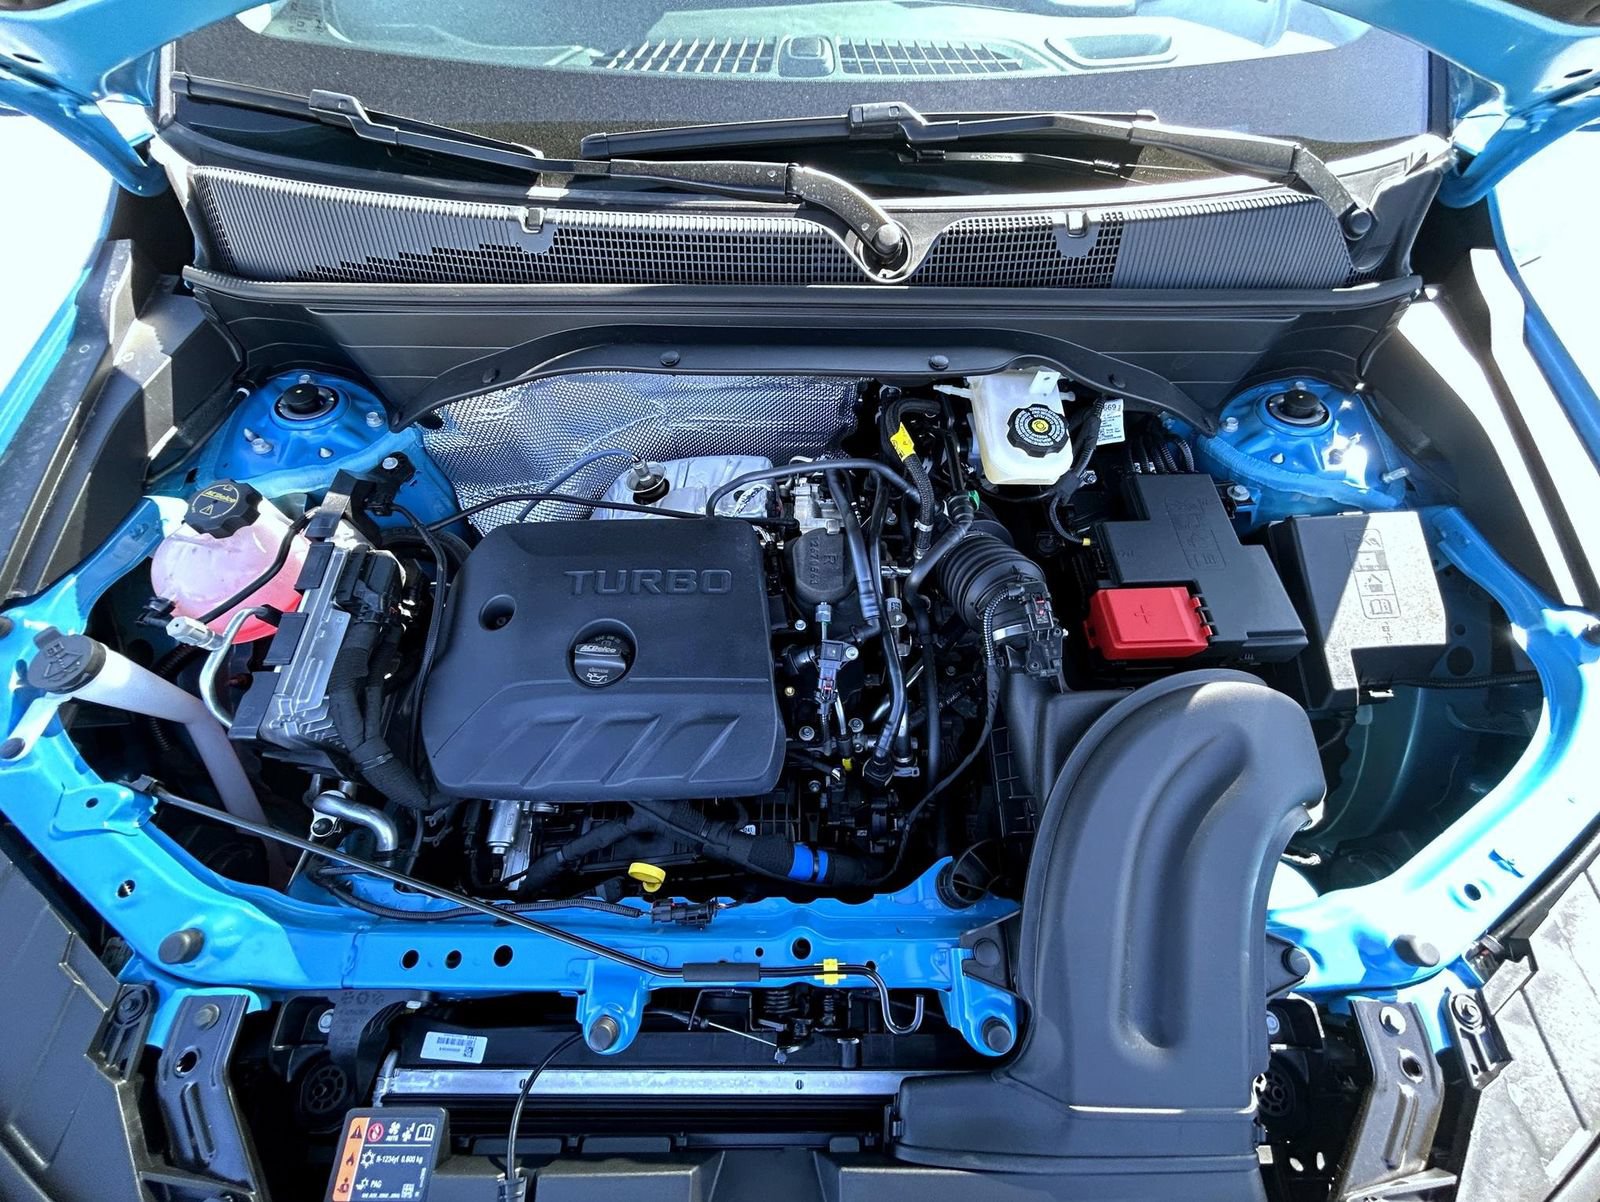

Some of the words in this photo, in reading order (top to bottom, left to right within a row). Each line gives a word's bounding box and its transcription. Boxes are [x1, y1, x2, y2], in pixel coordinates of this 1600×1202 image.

[563, 569, 732, 595] TURBO
[579, 644, 617, 653] ACDelco
[370, 1179, 383, 1189] PAG
